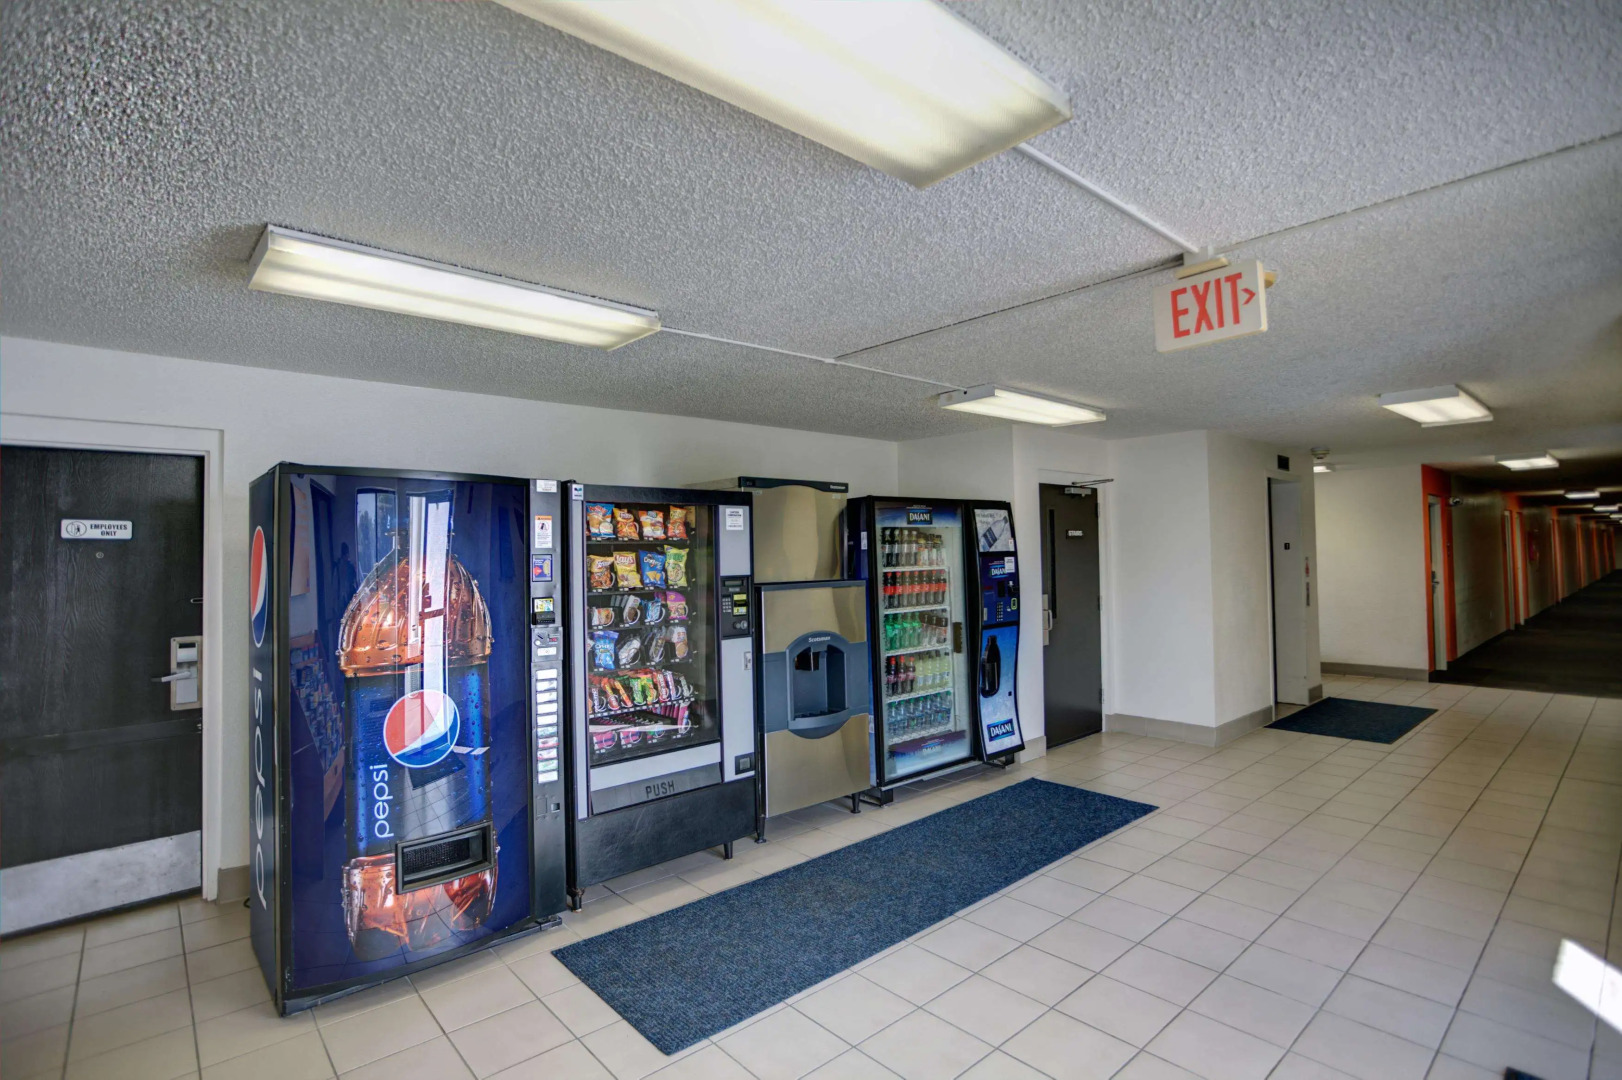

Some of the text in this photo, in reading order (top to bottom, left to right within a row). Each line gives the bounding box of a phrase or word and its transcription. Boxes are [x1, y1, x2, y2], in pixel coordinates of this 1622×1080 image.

[1170, 272, 1242, 339] EXIT
[990, 723, 1012, 737] DASANI
[253, 667, 267, 910] pepsi
[369, 764, 395, 838] pepsi
[645, 780, 675, 798] PUSH
